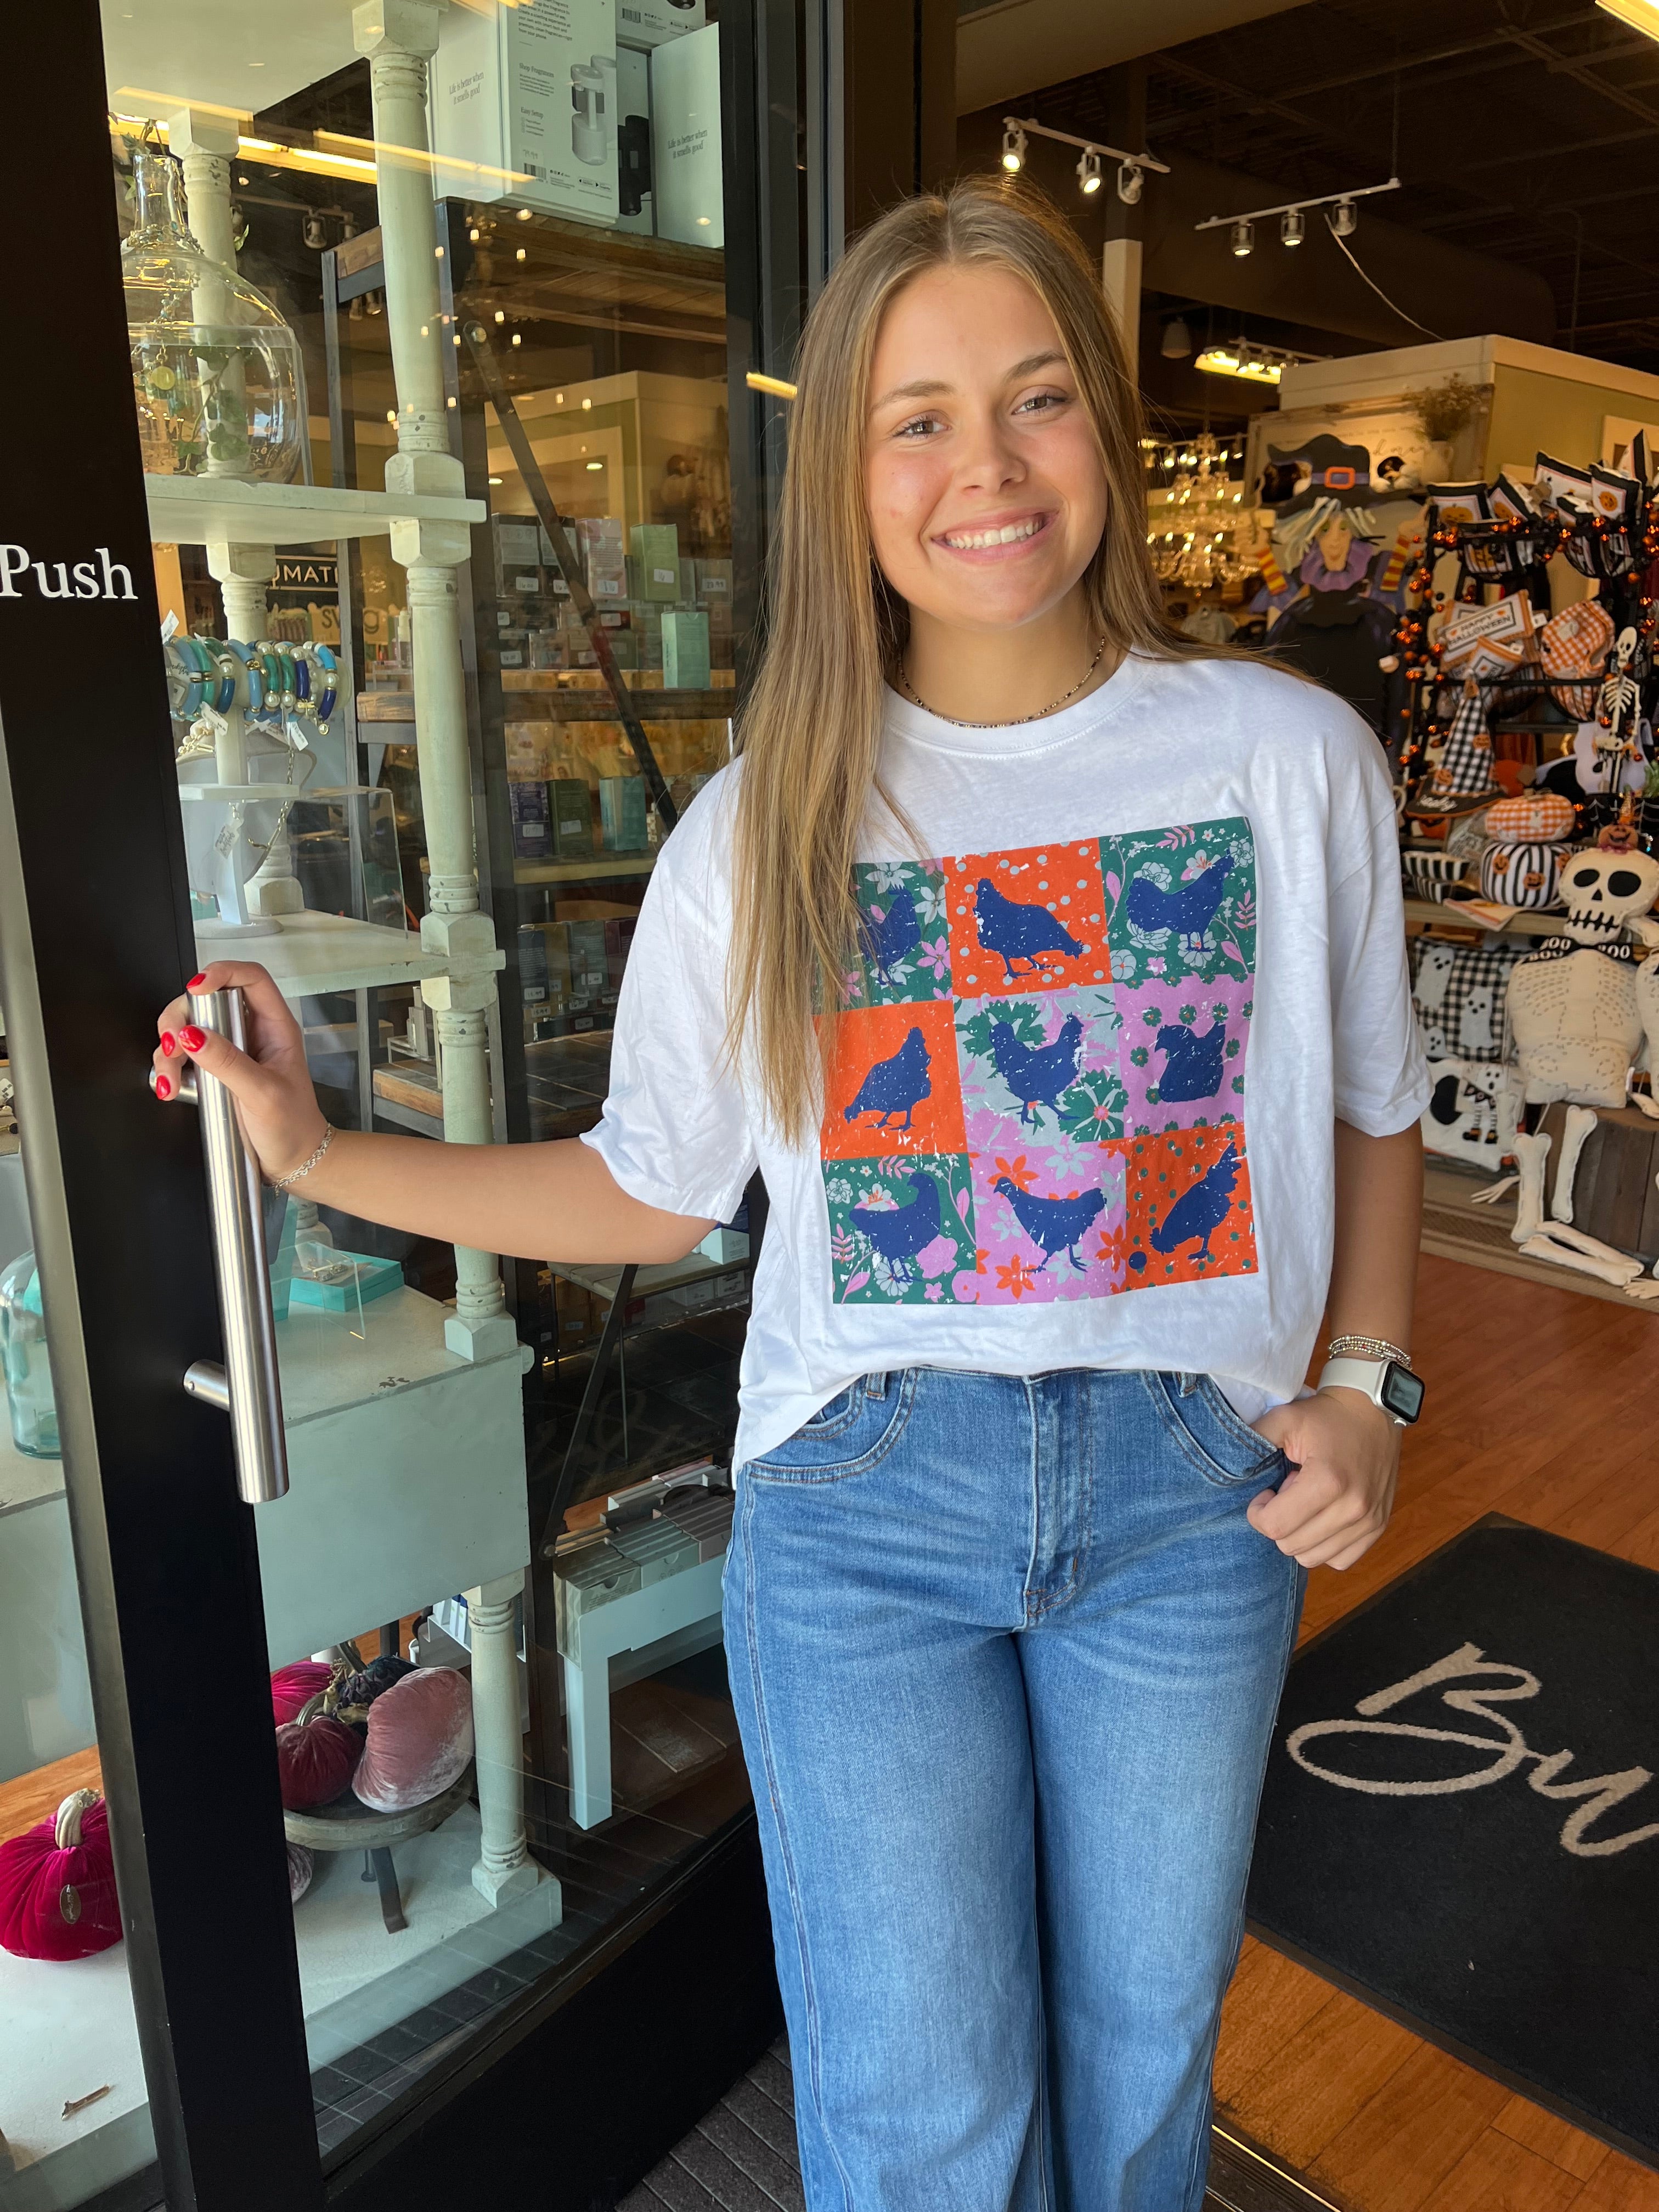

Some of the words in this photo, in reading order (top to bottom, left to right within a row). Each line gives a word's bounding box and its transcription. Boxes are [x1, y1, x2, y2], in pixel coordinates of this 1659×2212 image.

[0, 544, 138, 599] Push
[1448, 614, 1511, 646] HALLOWEEN
[1461, 613, 1494, 631] HAPPY
